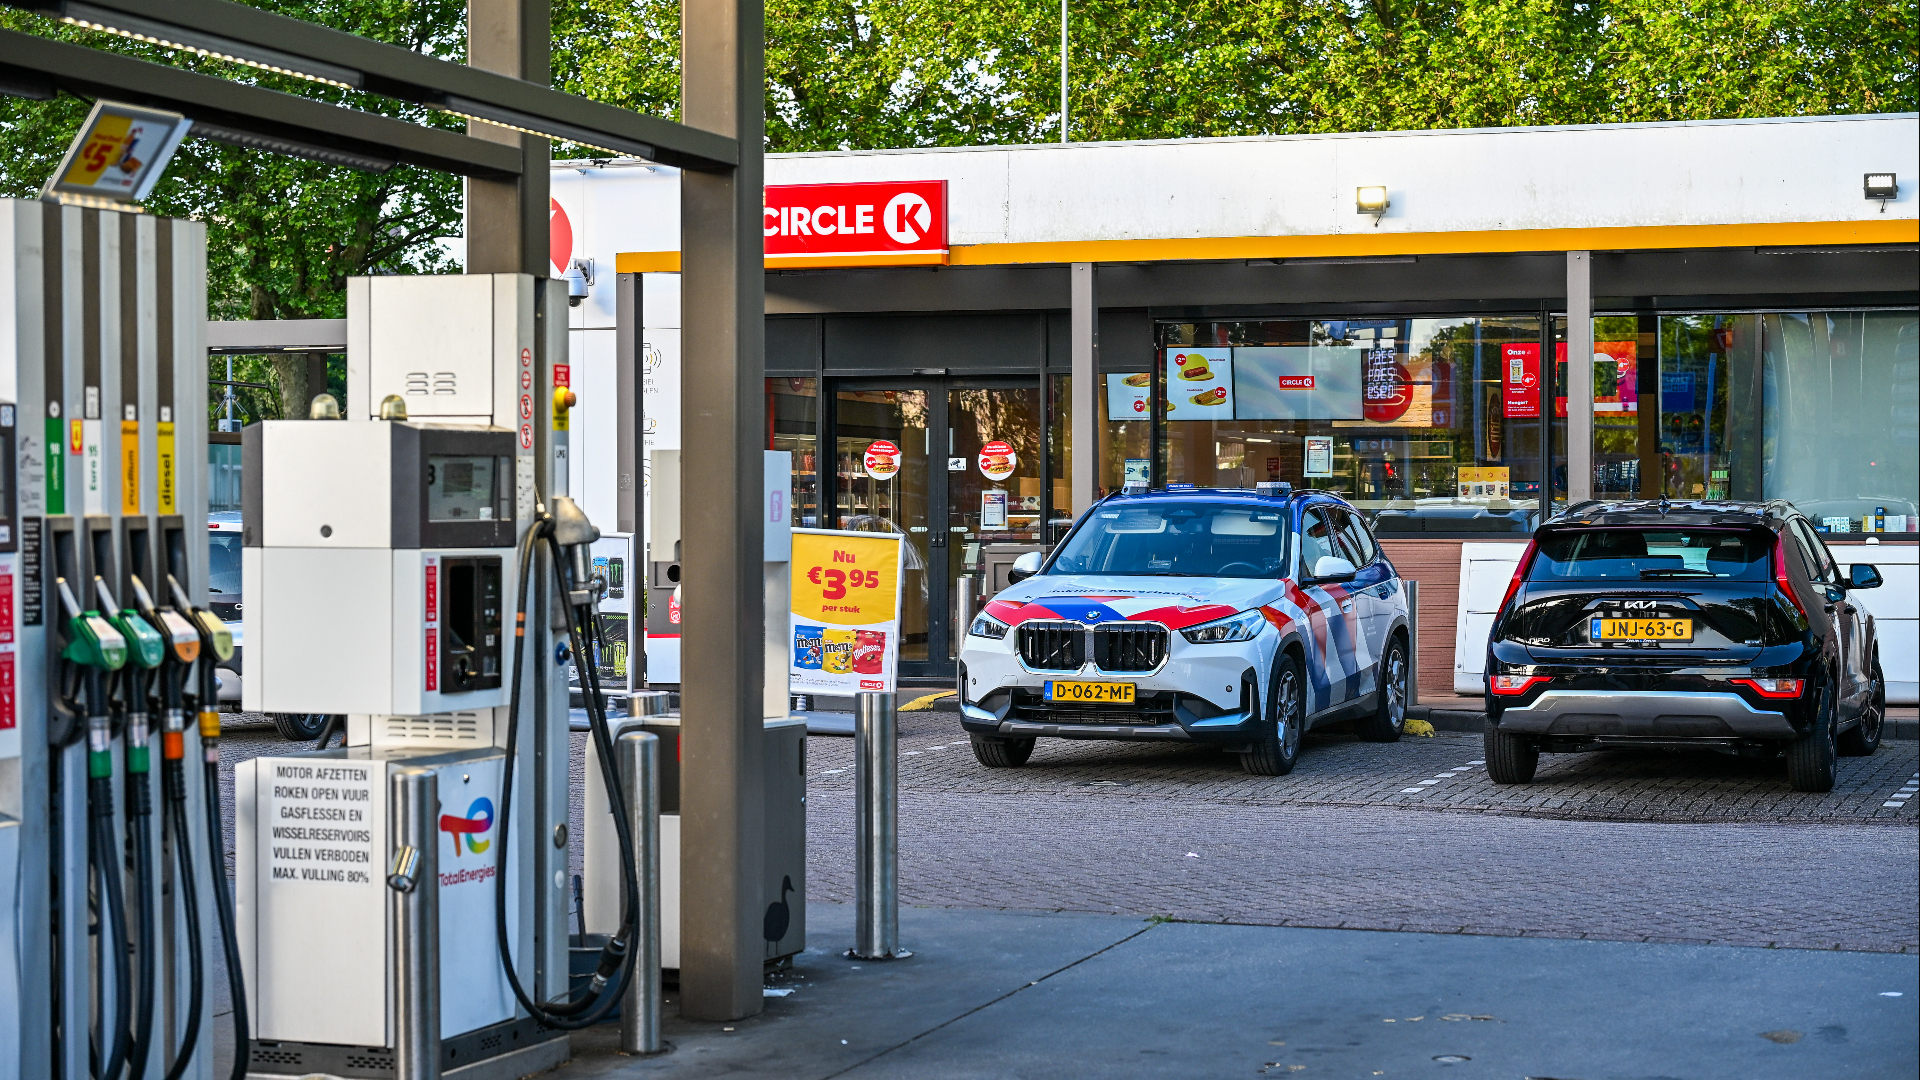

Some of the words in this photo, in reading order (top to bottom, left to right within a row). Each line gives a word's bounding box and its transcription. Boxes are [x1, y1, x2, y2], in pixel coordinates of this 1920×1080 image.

[764, 204, 875, 237] CIRCLE
[894, 201, 927, 241] K
[1304, 378, 1312, 387] K
[89, 460, 98, 491] Euro
[160, 453, 171, 506] diesel
[833, 550, 856, 564] Nu
[822, 604, 838, 613] per
[839, 605, 861, 614] stuk
[1607, 621, 1684, 637] JNJ-63-G
[853, 644, 881, 661] Maltesers
[1056, 684, 1133, 700] D-062-MF
[276, 766, 313, 780] MOTOR
[316, 767, 367, 781] AFZETTEN
[274, 786, 308, 799] ROKEN
[311, 787, 339, 800] OPEN
[342, 788, 369, 801] VUUR
[280, 806, 346, 821] GASFLESSEN
[349, 809, 363, 822] EN
[272, 826, 370, 843] WISSELRESERVOIRS
[273, 847, 311, 860] VULLEN
[314, 849, 369, 863] VERBODEN
[273, 867, 299, 880] MAX.
[301, 869, 345, 882] VULLING
[347, 871, 369, 884] 80%
[438, 864, 496, 887] TotalEnergies
